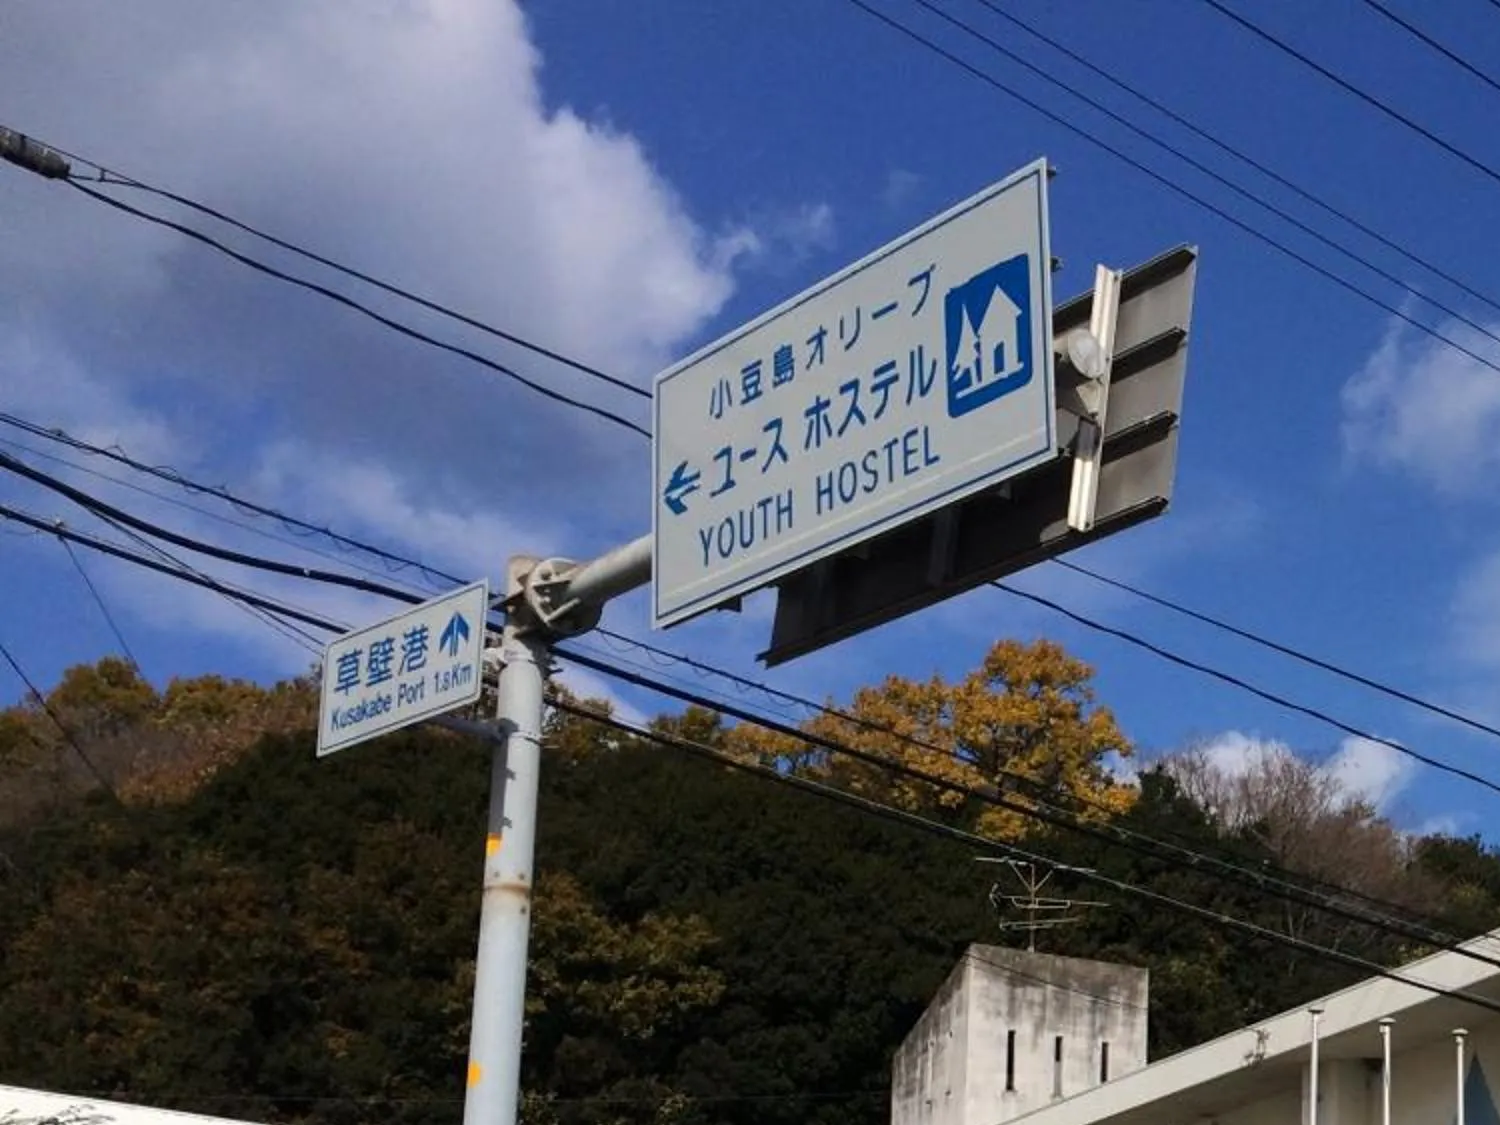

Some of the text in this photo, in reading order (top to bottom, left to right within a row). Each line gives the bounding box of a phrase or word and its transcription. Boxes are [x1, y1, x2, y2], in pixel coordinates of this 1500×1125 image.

[699, 425, 940, 567] YOUTH HOSTEL
[334, 623, 429, 696] 草壁港
[331, 692, 392, 731] Kusakabe
[397, 676, 425, 708] Port
